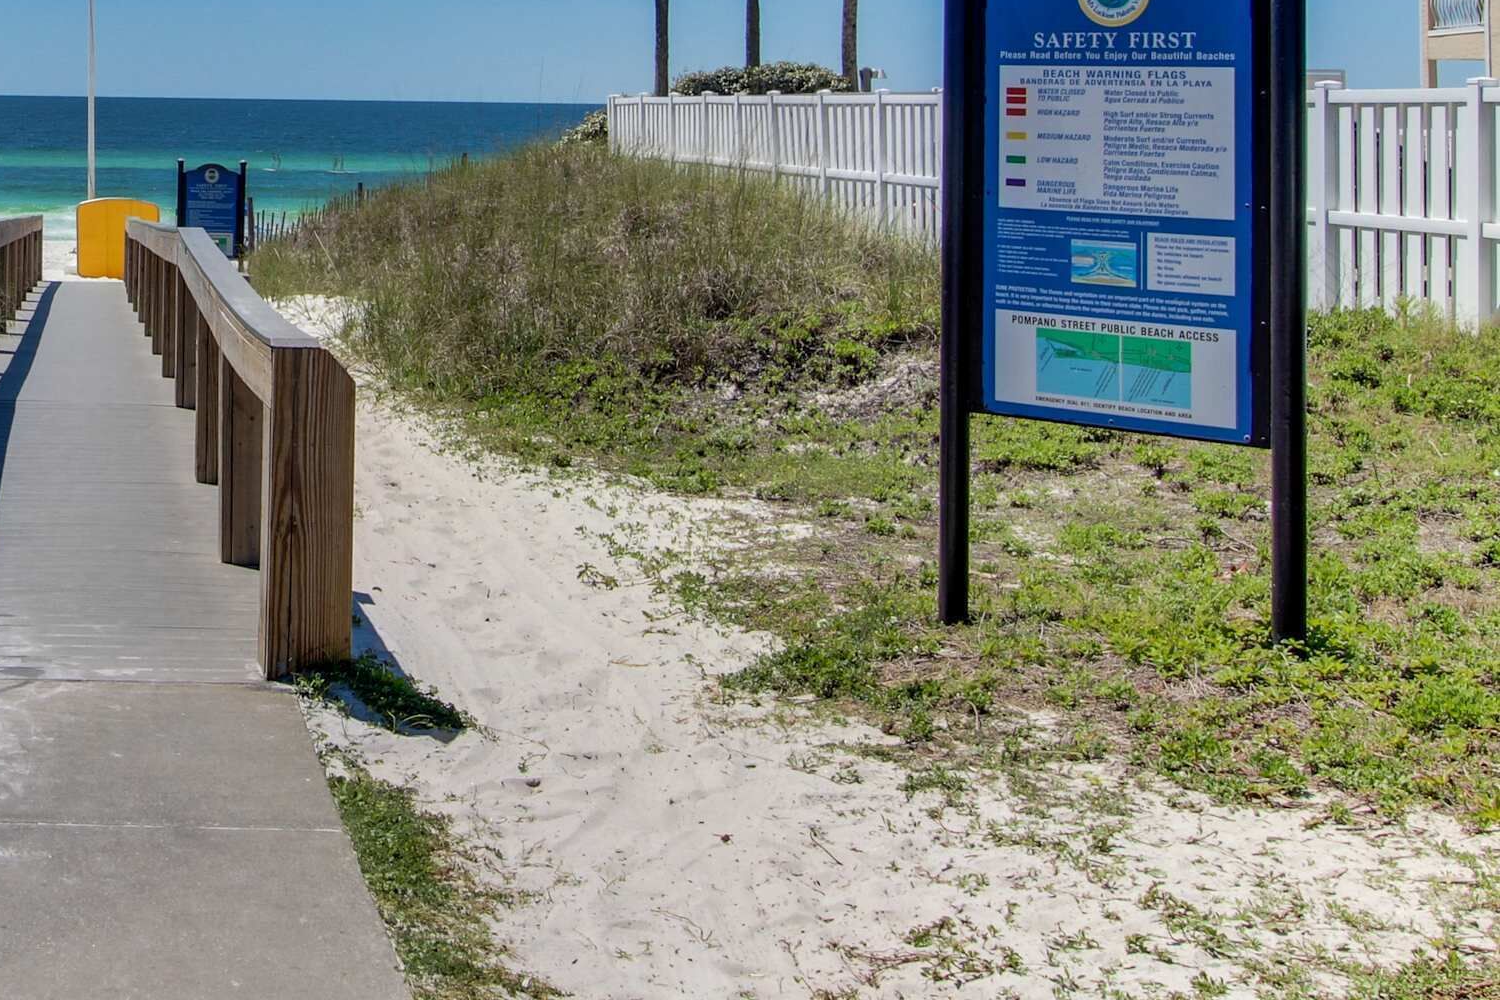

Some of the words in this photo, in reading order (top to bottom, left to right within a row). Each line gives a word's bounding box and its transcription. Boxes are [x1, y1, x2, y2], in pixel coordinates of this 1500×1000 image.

[1034, 32, 1118, 48] SAFETY
[1129, 32, 1196, 48] FIRST
[1000, 50, 1026, 60] Please
[1030, 50, 1050, 60] Read
[1054, 50, 1080, 60] Before
[1086, 51, 1100, 60] You
[1104, 51, 1128, 62] Enjoy
[1132, 51, 1147, 60] Our
[1151, 51, 1192, 60] Beautiful
[1196, 52, 1235, 60] Beaches
[1044, 70, 1080, 78] BEACH
[1086, 70, 1140, 79] WARNING
[1148, 70, 1186, 80] FLAGS
[1054, 109, 1080, 117] HAZARD
[1104, 111, 1118, 119] High
[1160, 112, 1182, 122] Strong
[1184, 112, 1214, 120] Currents
[1104, 118, 1128, 126] Peligro
[1064, 134, 1092, 142] HAZARD
[1176, 137, 1207, 145] Currents
[1104, 142, 1127, 150] Peligro
[1179, 144, 1214, 152] Moderada
[1052, 157, 1079, 166] HAZARD
[1103, 184, 1139, 192] Dangerous
[1144, 192, 1176, 200] Peligrosa
[1012, 314, 1056, 328] POMPANO
[1061, 319, 1096, 331] STREET
[1101, 323, 1136, 335] PUBLIC
[1141, 326, 1174, 338] BEACH
[1179, 330, 1220, 342] ACCESS
